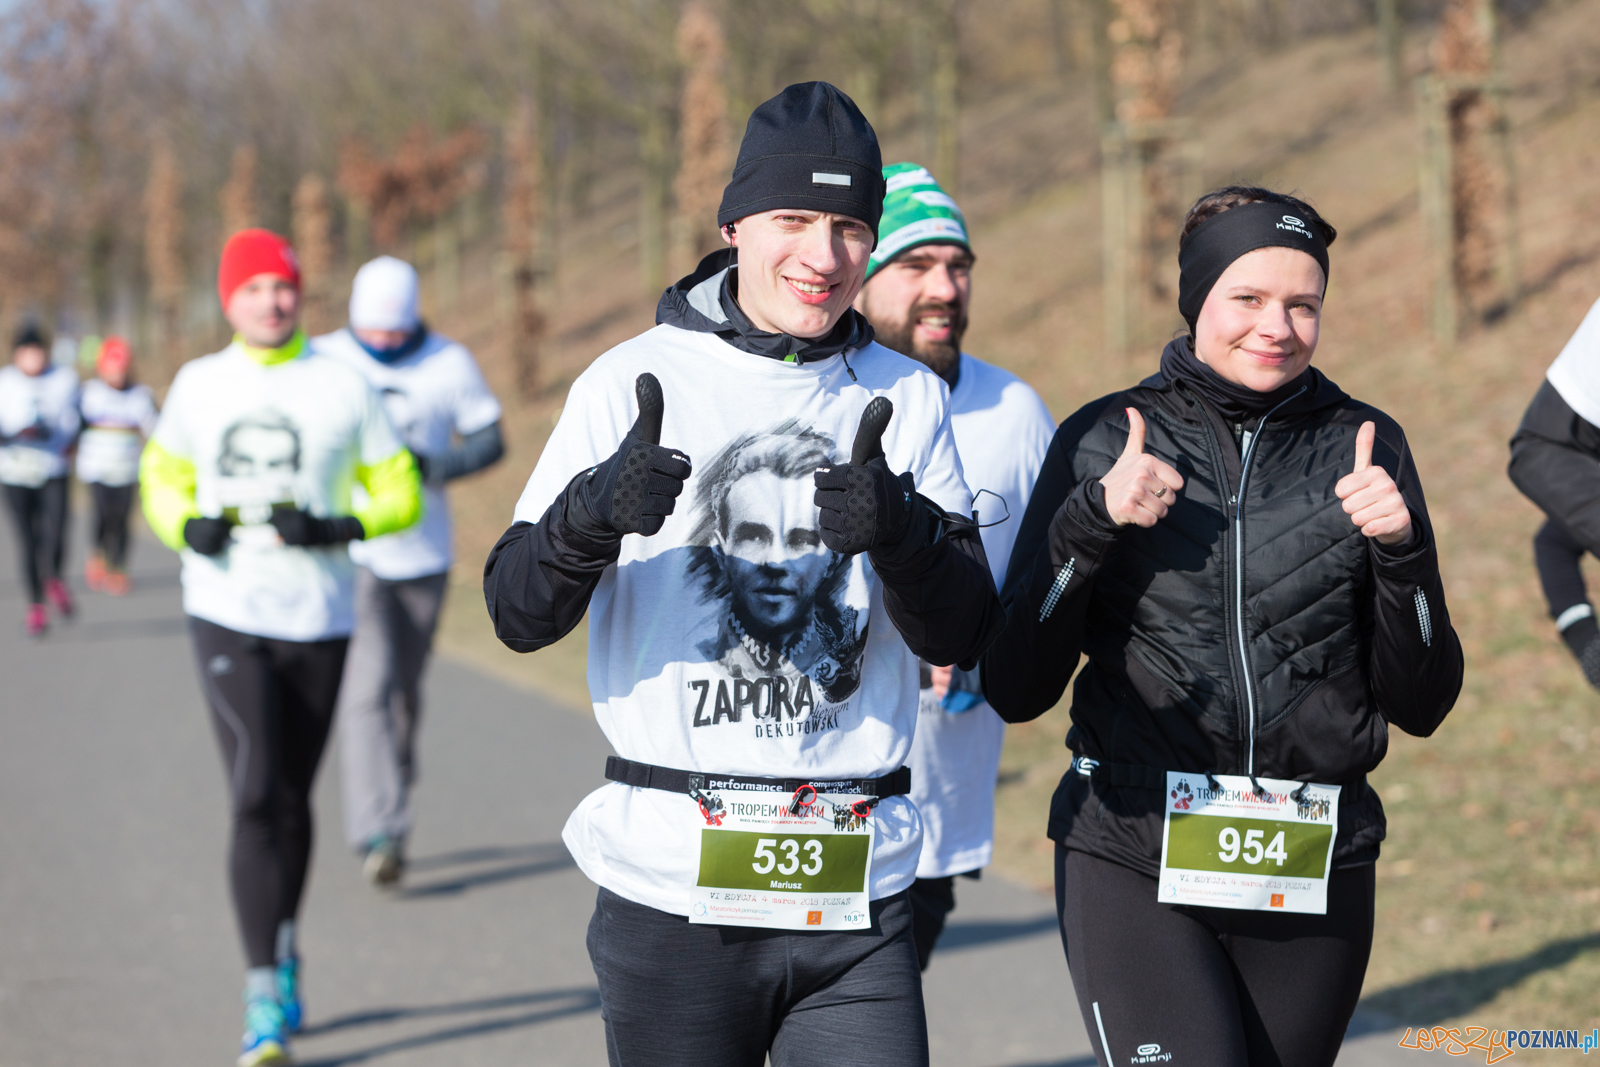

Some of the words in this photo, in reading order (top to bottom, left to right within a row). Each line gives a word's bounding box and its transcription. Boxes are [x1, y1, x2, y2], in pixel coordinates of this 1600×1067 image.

[690, 675, 814, 727] ZAPORA
[755, 712, 838, 737] DEKUTOWSKI
[709, 779, 783, 791] performance
[1218, 827, 1287, 866] 954
[752, 838, 823, 876] 533
[770, 880, 802, 890] Mariusz
[710, 892, 720, 900] VI
[724, 893, 757, 902] EDYCJA
[1131, 1052, 1172, 1064] Kalenji
